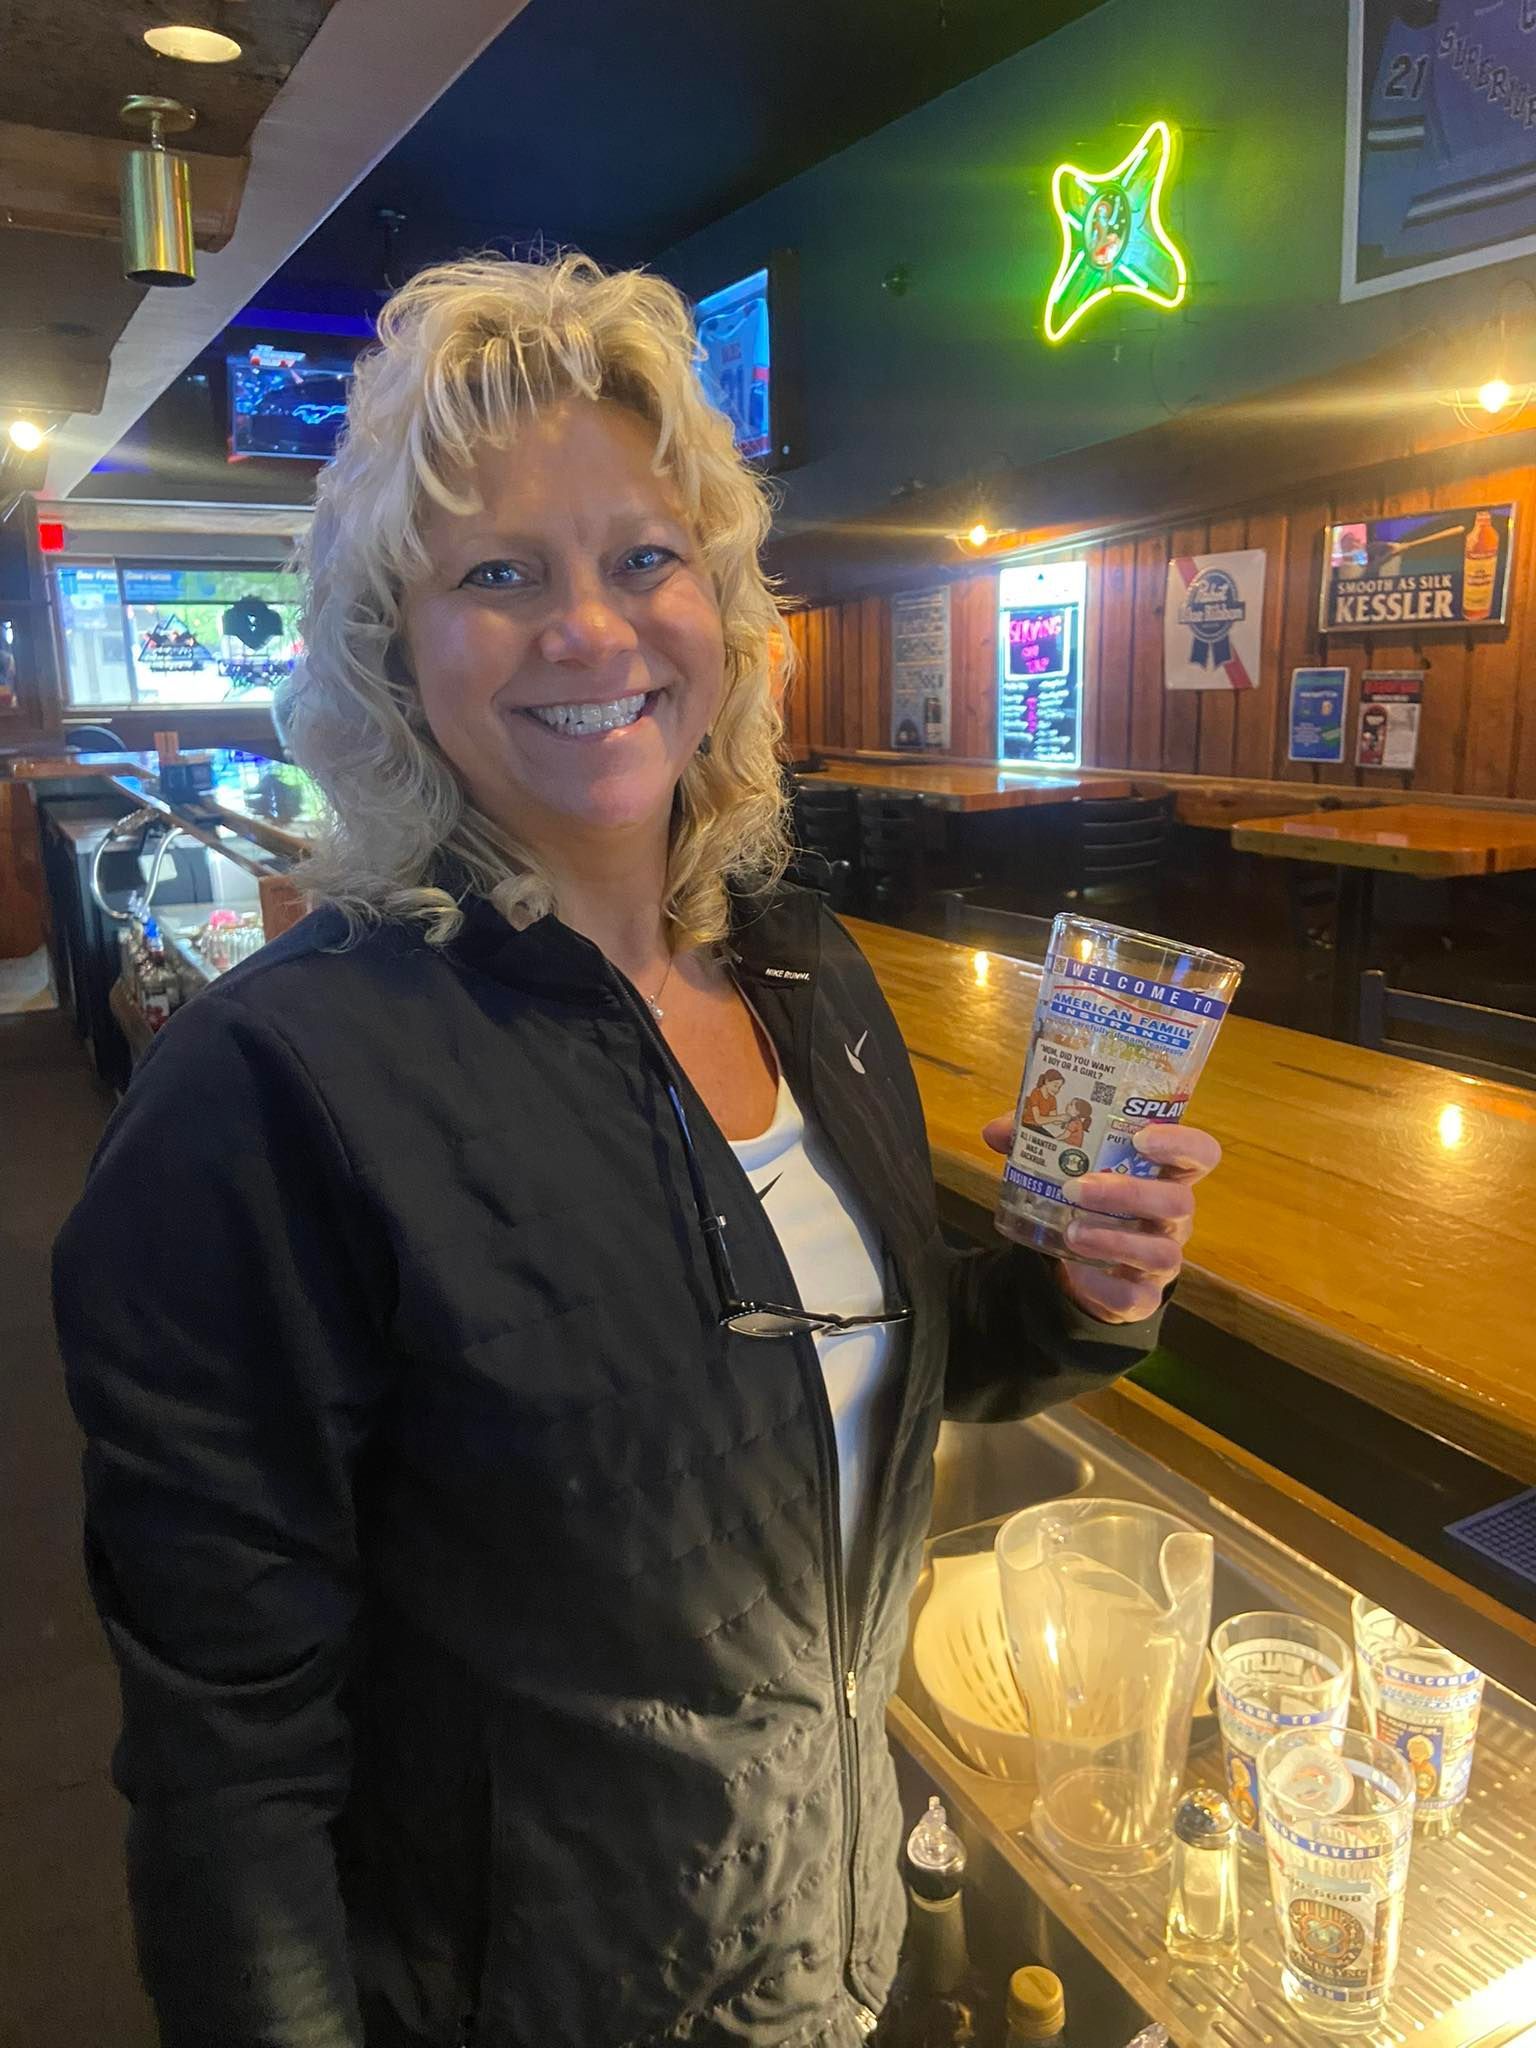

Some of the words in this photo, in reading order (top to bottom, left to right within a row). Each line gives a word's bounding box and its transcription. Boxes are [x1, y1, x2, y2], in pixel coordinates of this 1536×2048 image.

[1385, 53, 1428, 100] 21
[1337, 578, 1393, 594] SMOOTH
[1399, 577, 1416, 590] AS
[1419, 574, 1453, 590] SILK
[1335, 589, 1454, 623] KESSLER
[765, 968, 784, 978] NIKE
[1072, 962, 1181, 1005] WELCOME
[1194, 997, 1212, 1014] TO
[1054, 993, 1132, 1022] AMERICAN
[1139, 1016, 1194, 1039] FAMILY
[1058, 1005, 1182, 1046] INSURANCE
[1060, 1050, 1072, 1061] DID
[1074, 1054, 1090, 1066] YOU
[1091, 1060, 1116, 1074] WANT
[1061, 1061, 1071, 1070] OR
[1072, 1065, 1078, 1073] A
[1080, 1067, 1103, 1079] GIRL?
[1032, 1136, 1057, 1151] WANTED
[1107, 1134, 1126, 1145] PUT
[1009, 1168, 1043, 1194] BUSINESS
[1389, 1669, 1467, 1688] WELCOME
[1291, 1714, 1311, 1725] TO
[1308, 1842, 1376, 1859] TAVERN
